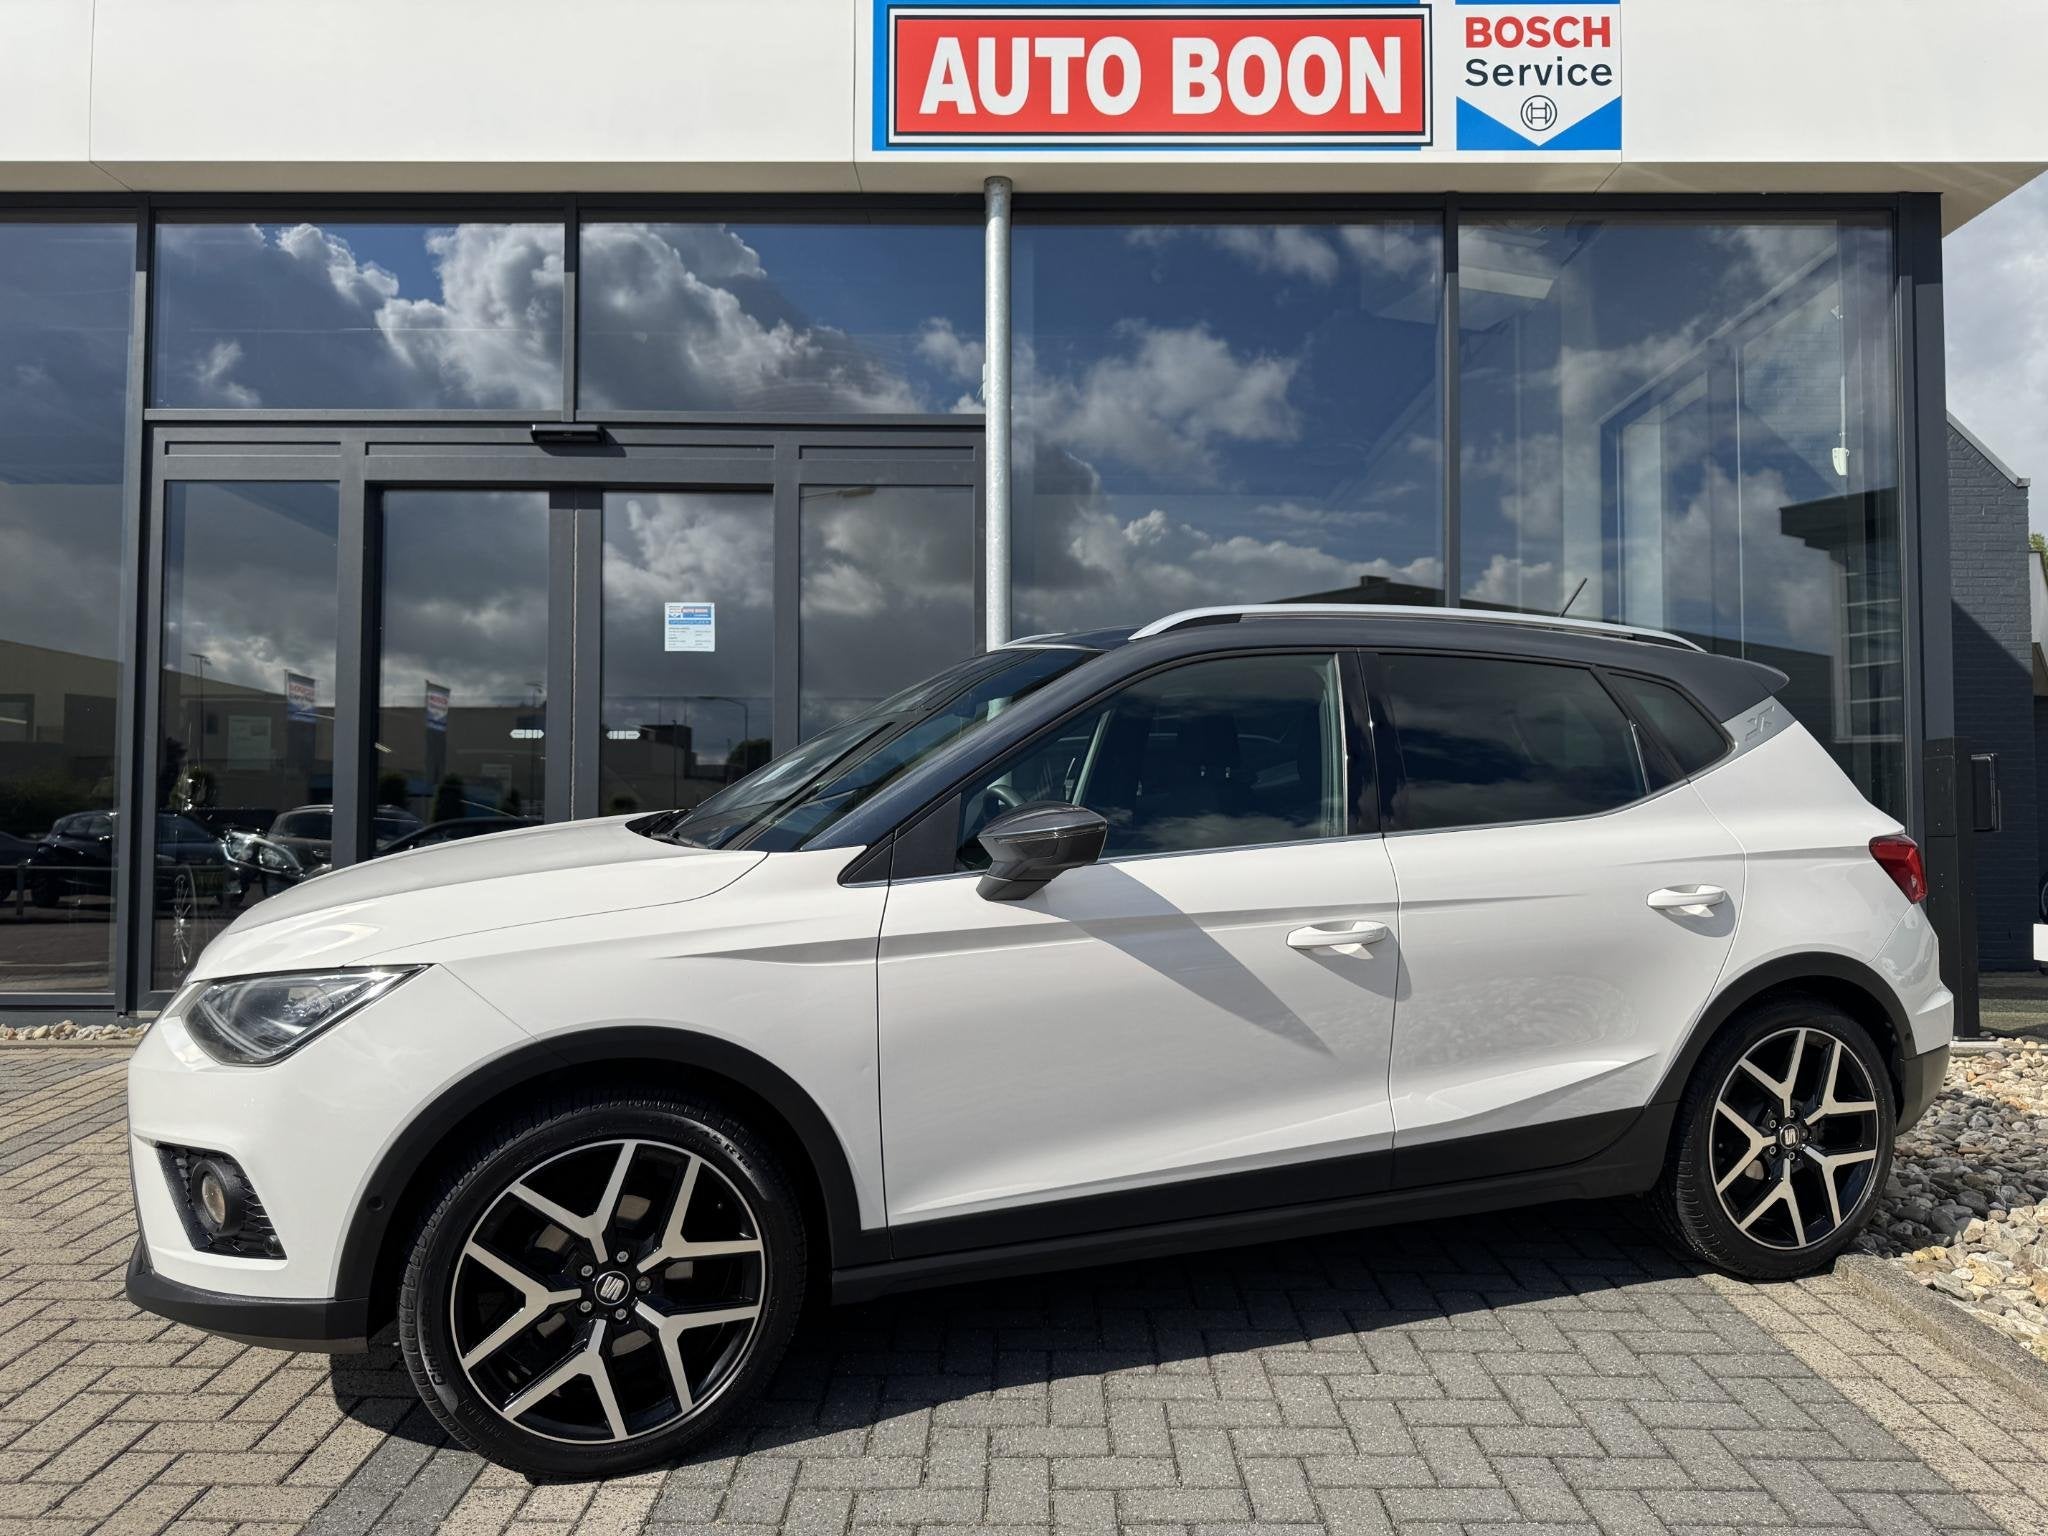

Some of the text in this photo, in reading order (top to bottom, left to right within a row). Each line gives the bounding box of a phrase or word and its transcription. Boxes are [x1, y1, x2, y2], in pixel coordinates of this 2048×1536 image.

[1465, 15, 1611, 49] BOSCH
[920, 35, 1402, 116] AUTO BOON
[1465, 56, 1612, 87] Service
